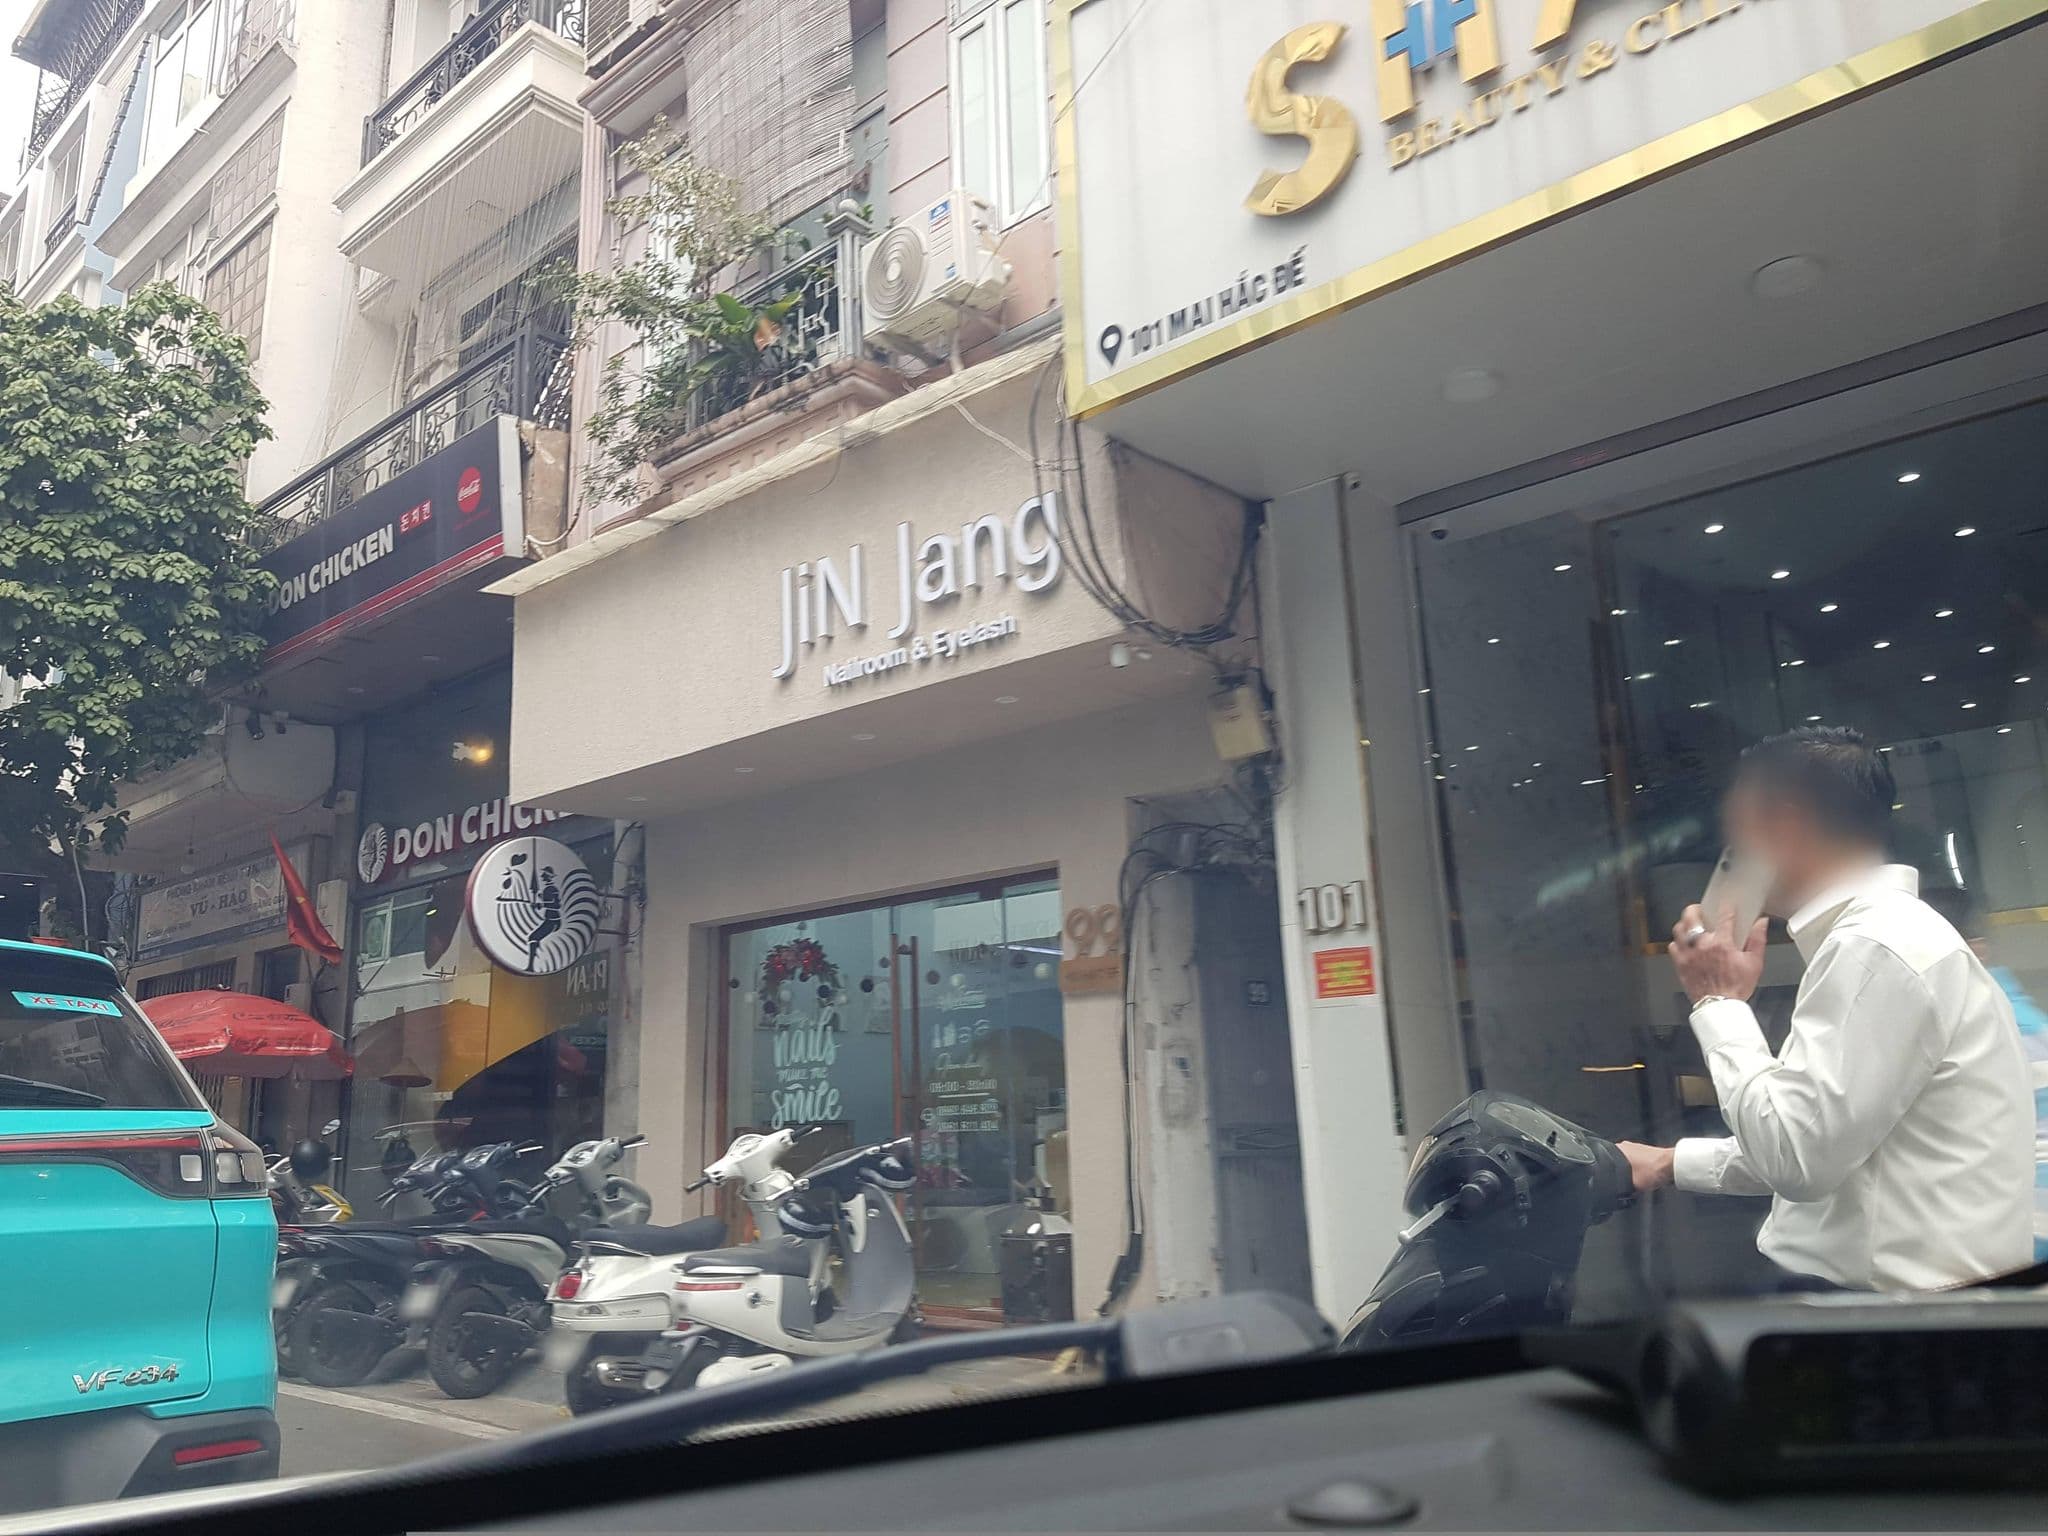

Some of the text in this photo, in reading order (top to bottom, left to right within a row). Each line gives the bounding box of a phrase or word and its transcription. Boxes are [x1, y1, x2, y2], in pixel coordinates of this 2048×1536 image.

[1386, 55, 1570, 170] BEAUTY
[1577, 38, 1617, 81] &
[1129, 320, 1163, 357] 101
[1167, 296, 1213, 341] MAI
[309, 523, 394, 594] CHICKEN
[772, 489, 1063, 680] JiN Jang
[823, 613, 1019, 688] Nailroom & Eyelash
[392, 813, 455, 866] DON
[1066, 904, 1122, 958] 99
[1298, 880, 1367, 936] 101
[64, 1000, 109, 1011] TAXI
[773, 1006, 840, 1068] nails
[771, 1080, 842, 1130] smile
[72, 1363, 179, 1394] VF e34
